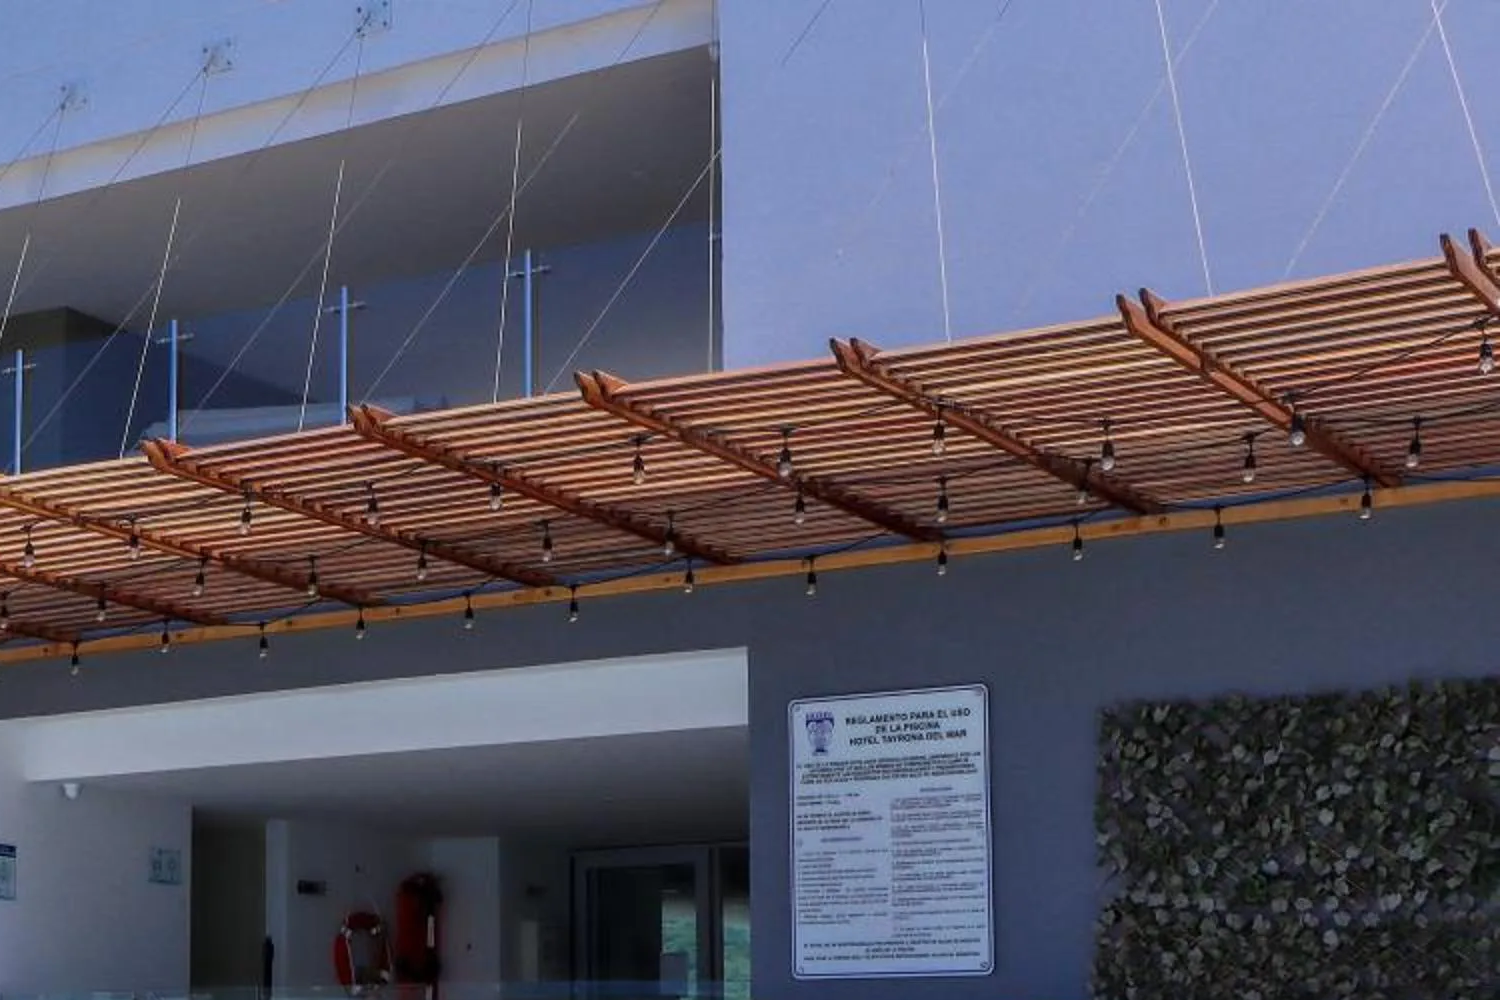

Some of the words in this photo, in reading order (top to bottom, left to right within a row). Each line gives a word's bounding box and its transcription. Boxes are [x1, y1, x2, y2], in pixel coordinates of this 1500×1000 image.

[845, 713, 908, 725] REGLAMENTO
[910, 711, 935, 719] PARA
[937, 709, 948, 718] EL
[950, 708, 970, 717] USO
[876, 724, 887, 734] DE
[890, 723, 902, 732] LA
[903, 721, 940, 731] PISCINA
[850, 735, 880, 746] HOTEL
[882, 732, 925, 743] TAYRONA
[926, 731, 944, 741] DEL
[946, 729, 967, 739] MAR
